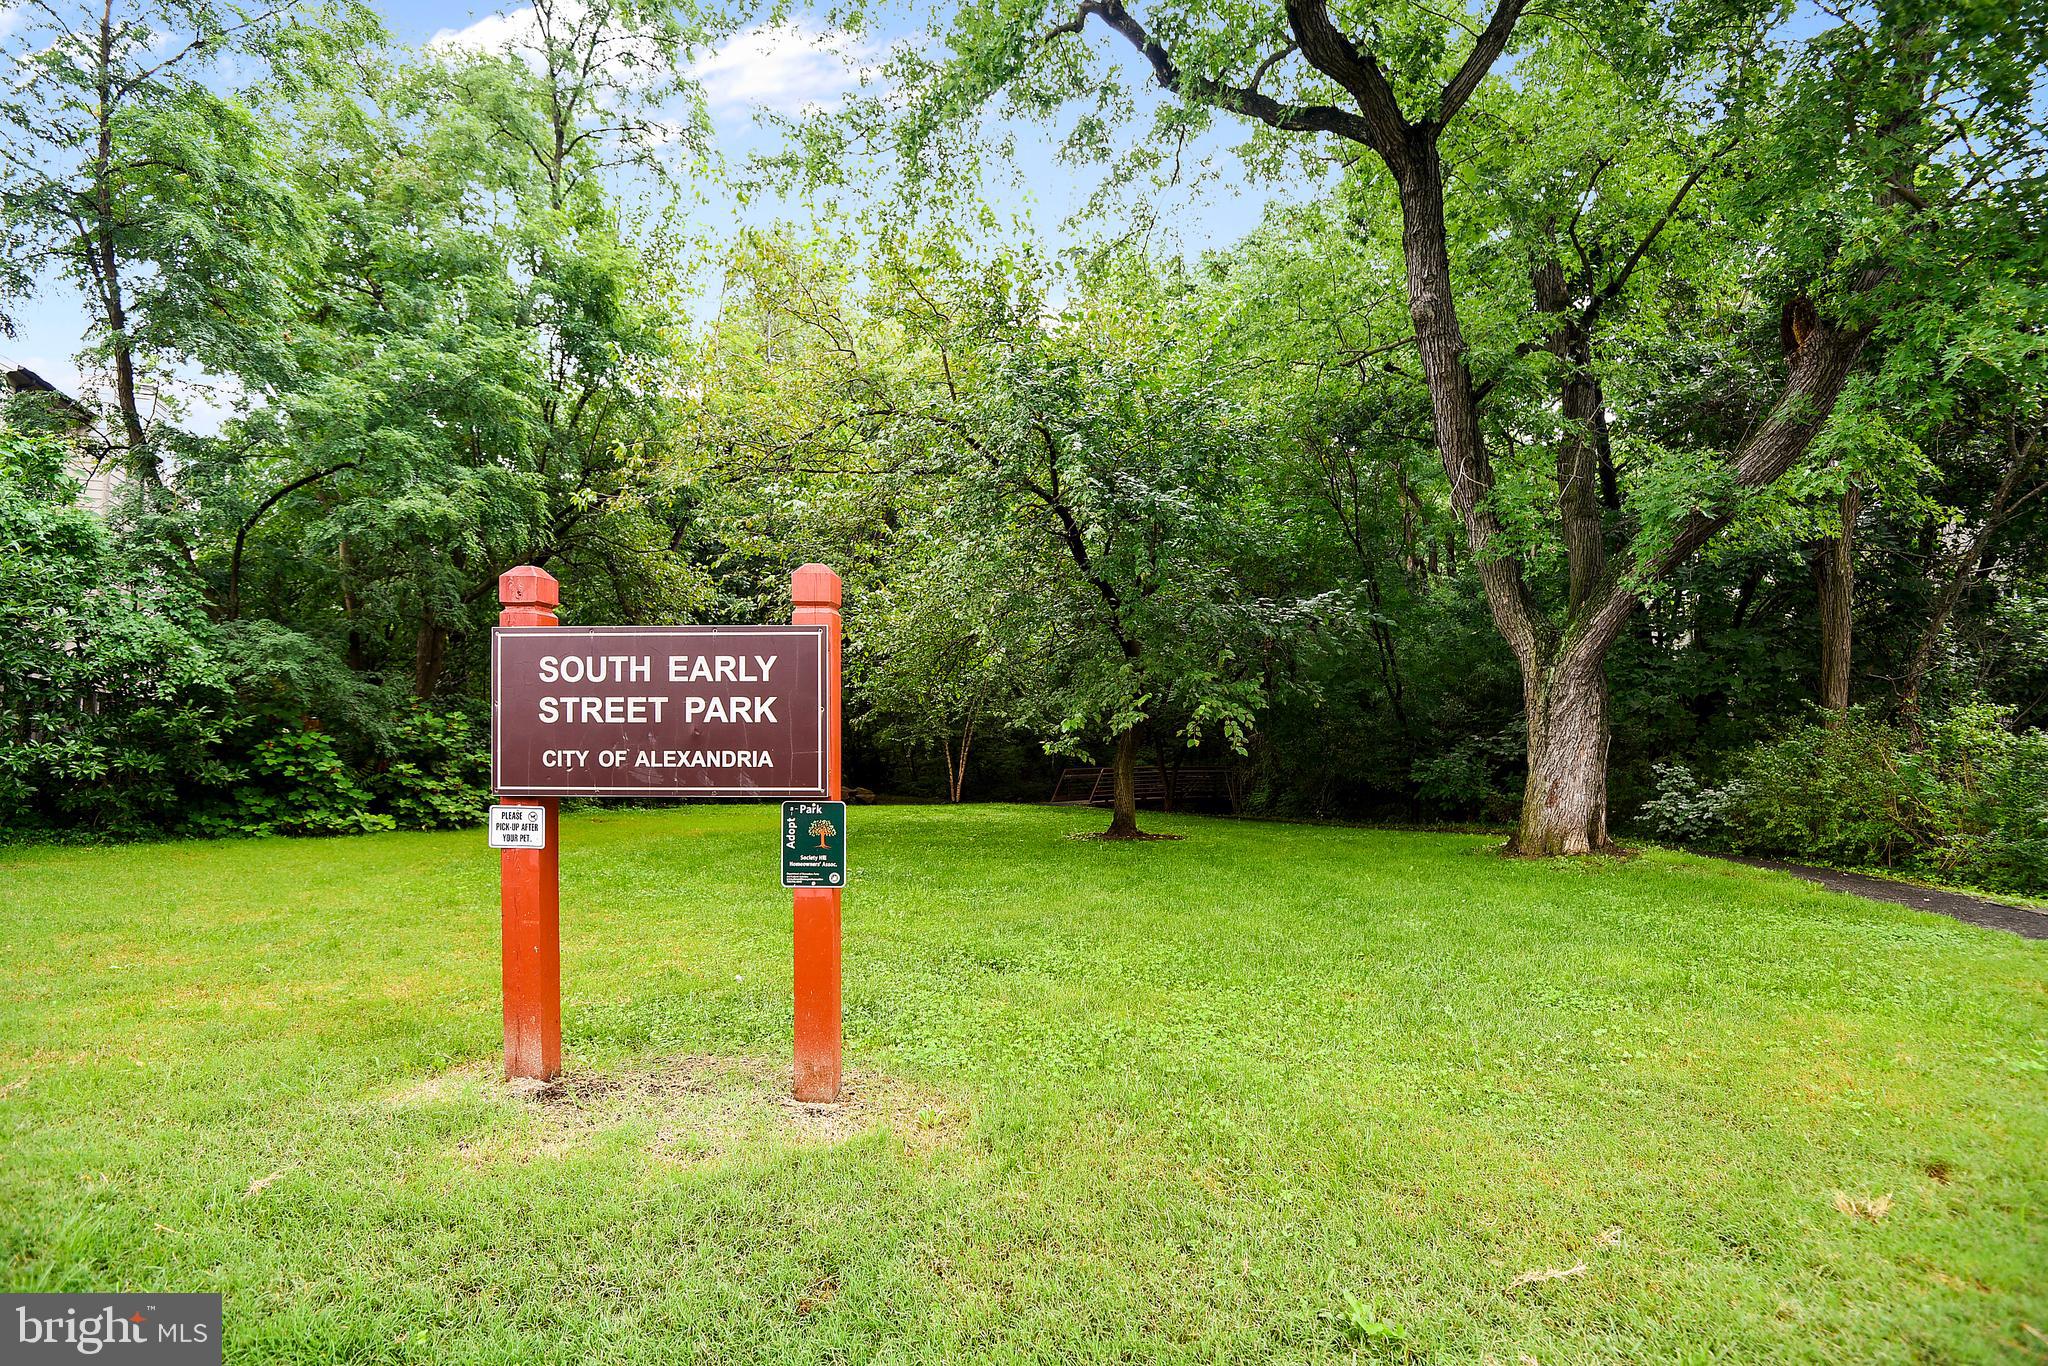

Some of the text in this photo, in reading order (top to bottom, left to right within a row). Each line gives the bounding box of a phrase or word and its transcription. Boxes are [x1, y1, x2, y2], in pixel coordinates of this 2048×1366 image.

[538, 655, 778, 683] SOUTH EARLY
[538, 696, 778, 723] STREET PARK
[542, 750, 774, 768] CITY OF ALEXANDRIA
[501, 811, 523, 820] PLEASE
[495, 822, 539, 832] PICK-UP AFTER
[502, 833, 519, 842] YOUR
